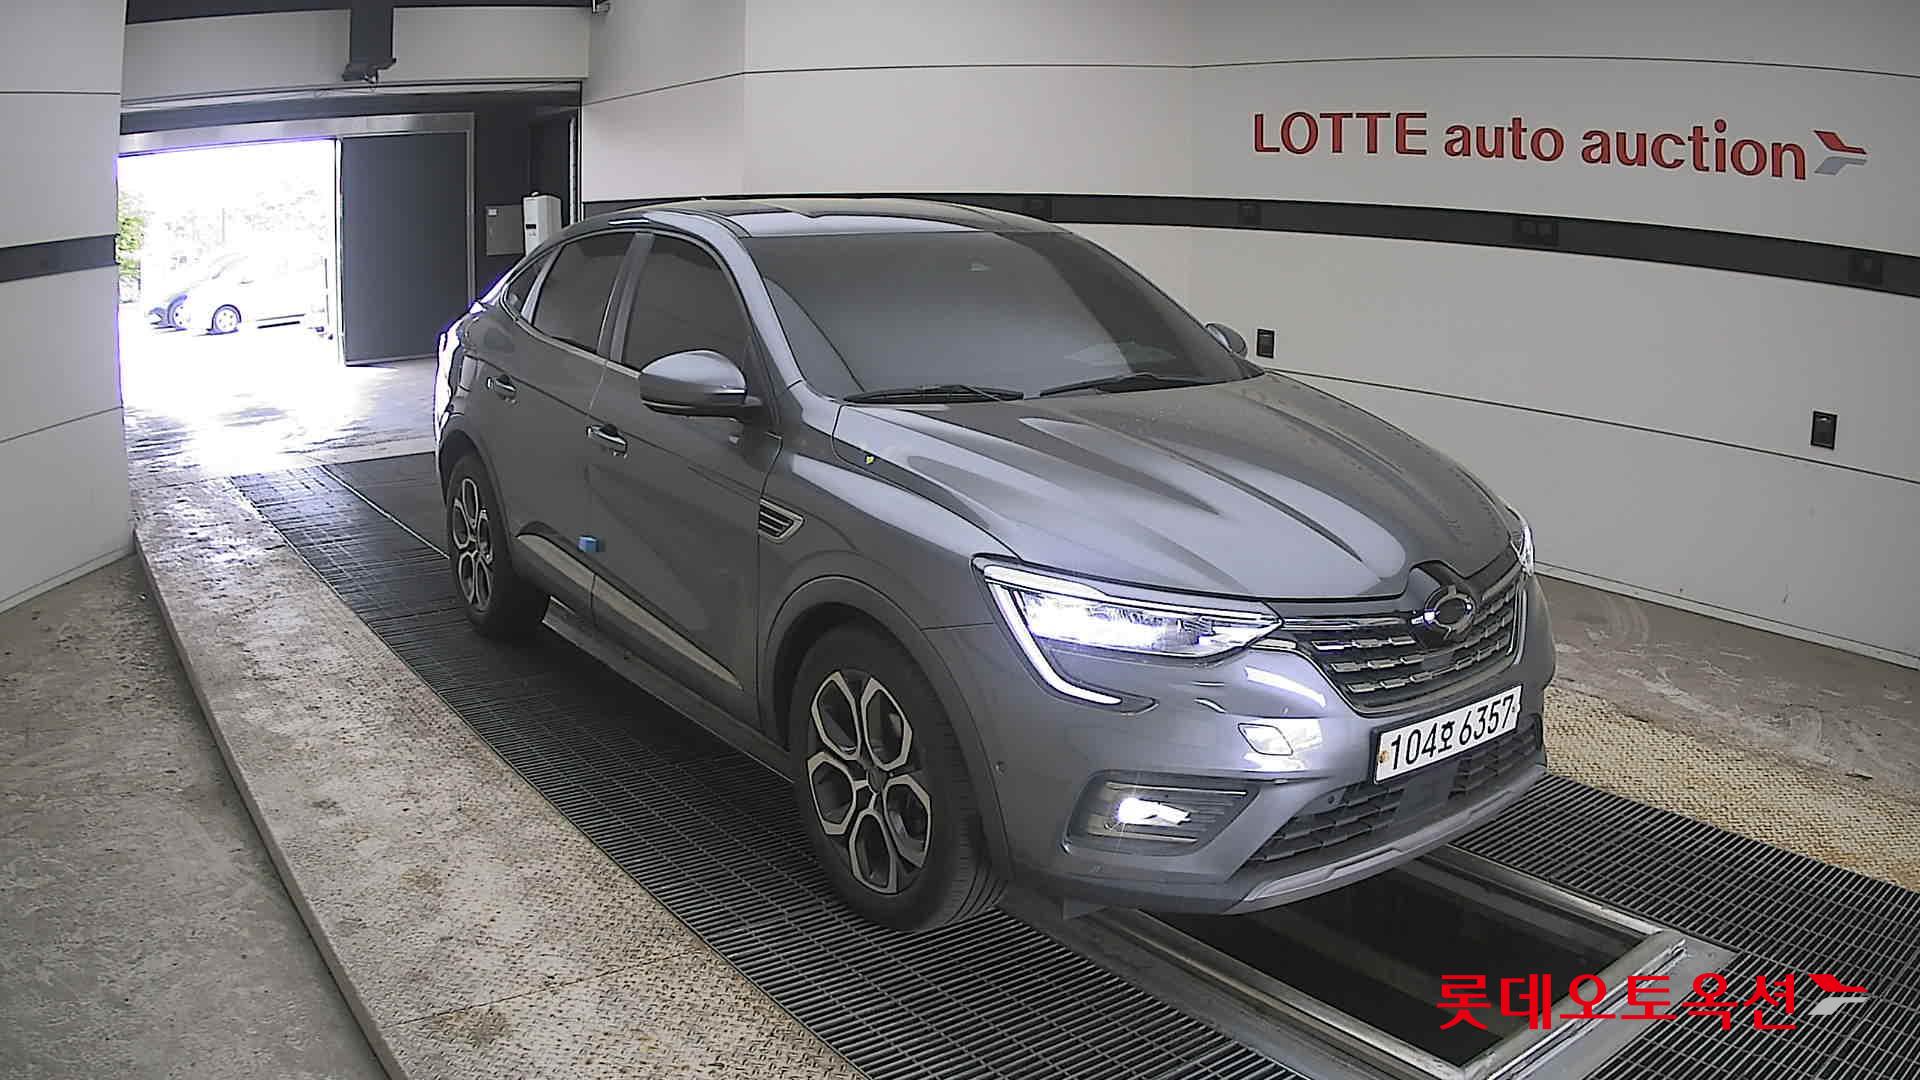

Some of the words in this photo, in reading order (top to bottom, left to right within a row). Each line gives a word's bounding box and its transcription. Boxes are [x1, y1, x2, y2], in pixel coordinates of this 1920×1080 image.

[1253, 111, 1428, 156] LOTTE
[1443, 116, 1566, 162] auto
[1581, 118, 1807, 181] auction
